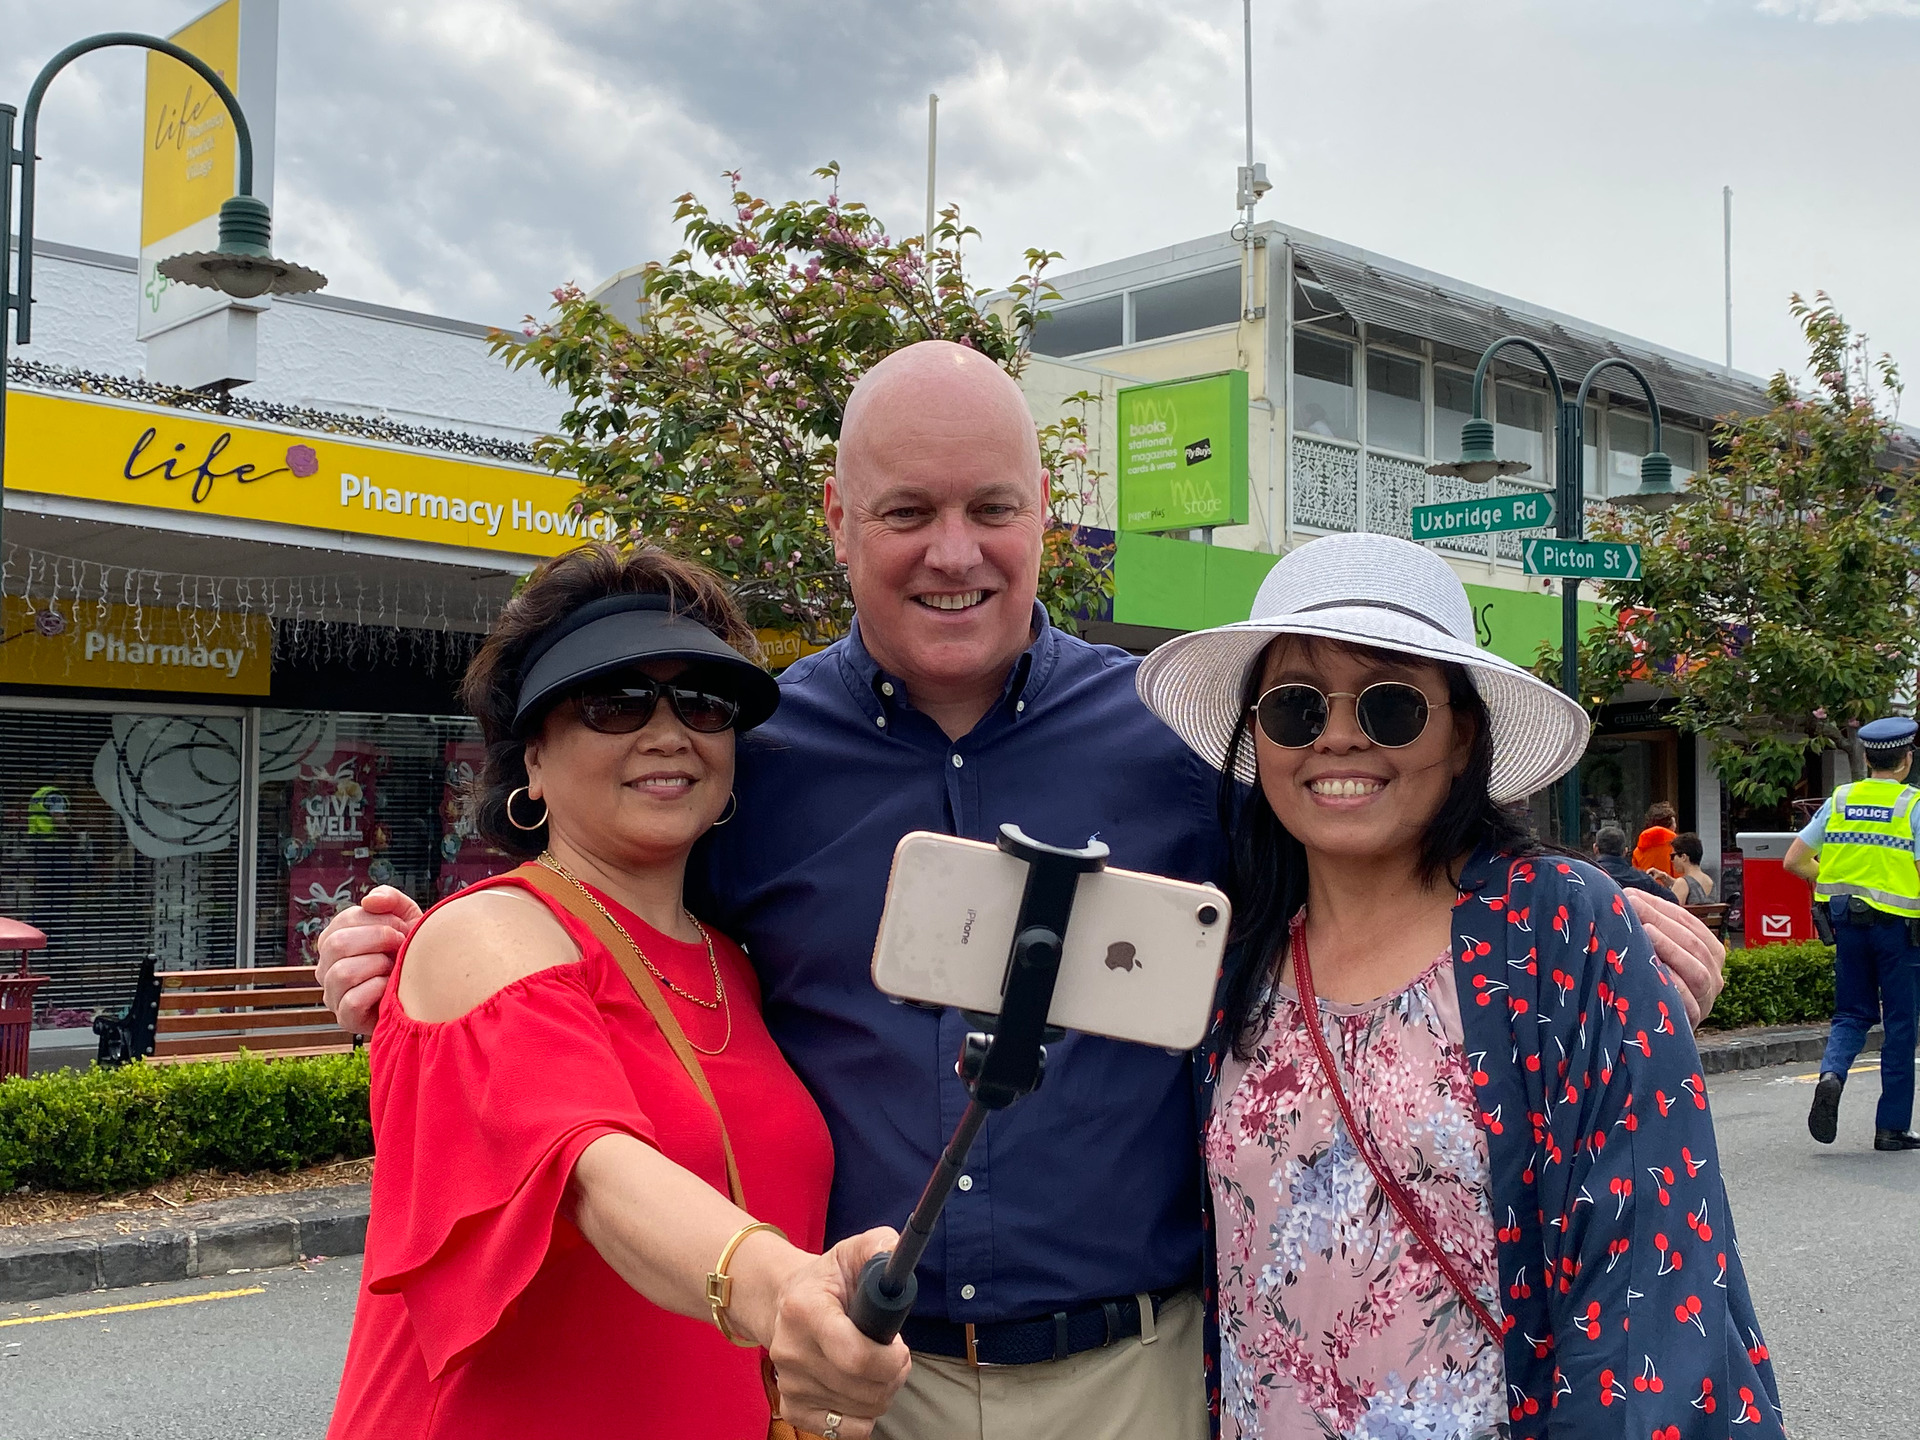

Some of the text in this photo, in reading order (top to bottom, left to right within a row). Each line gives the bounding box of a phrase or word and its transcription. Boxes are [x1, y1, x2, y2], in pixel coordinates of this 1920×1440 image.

[155, 85, 213, 150] life
[1129, 420, 1167, 437] books
[1128, 436, 1174, 450] stationery
[124, 427, 290, 503] life
[1131, 448, 1178, 463] magazines
[1127, 461, 1177, 475] cards & wrap
[340, 472, 504, 536] Pharmacy
[1184, 498, 1222, 515] store
[1420, 500, 1537, 530] Uxbridge Rd
[1544, 547, 1620, 570] Picton St
[84, 631, 243, 678] Pharmacy
[762, 638, 800, 658] macy
[1614, 713, 1664, 724] CINNAMO
[305, 795, 364, 817] GIVE
[1848, 808, 1889, 819] POLICE
[305, 816, 364, 836] WELL
[961, 908, 976, 945] iPhone
